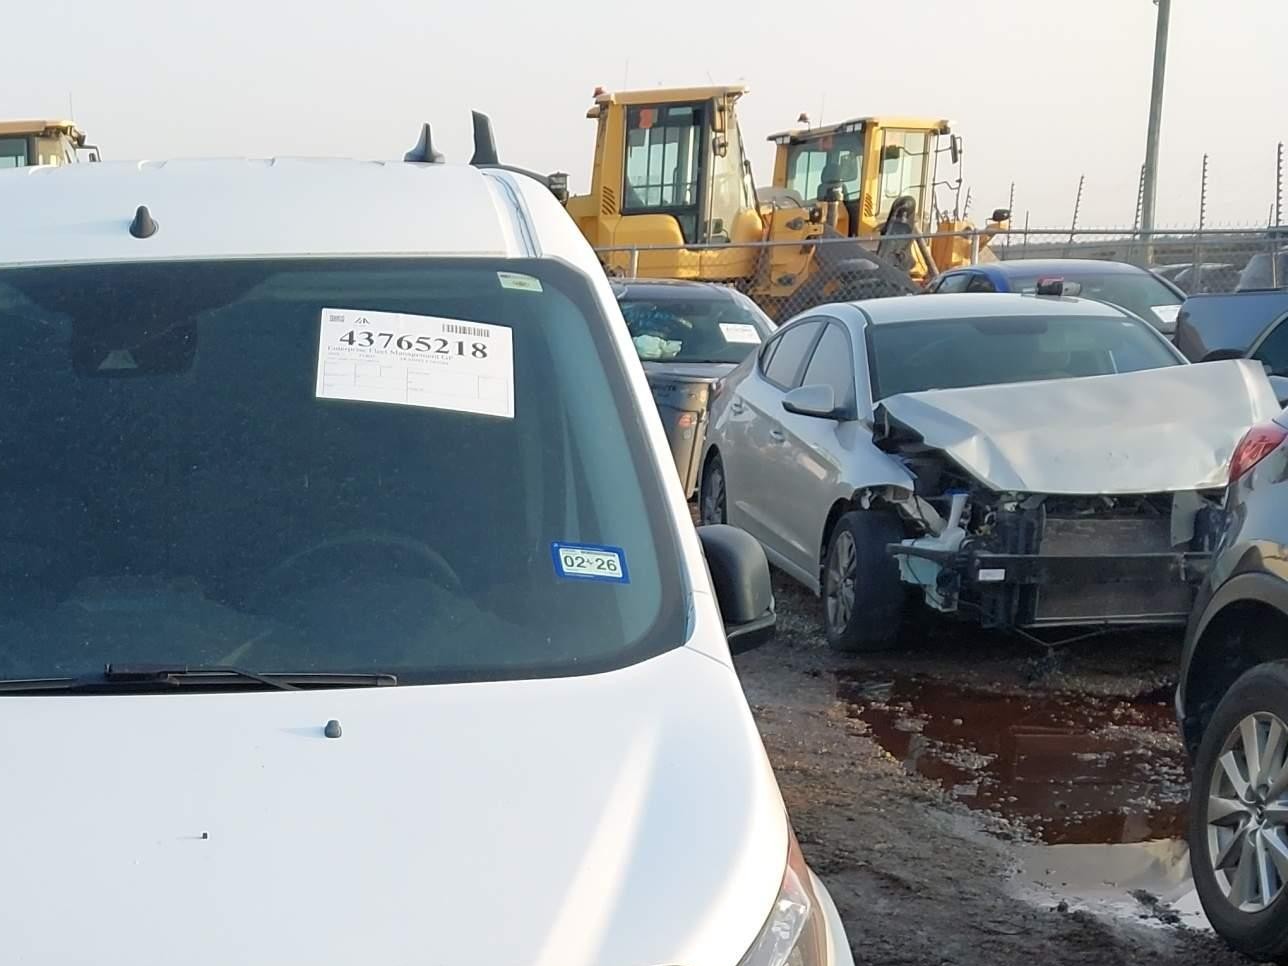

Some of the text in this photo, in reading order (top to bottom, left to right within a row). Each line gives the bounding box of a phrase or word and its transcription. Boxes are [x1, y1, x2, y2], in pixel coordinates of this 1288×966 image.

[339, 330, 488, 360] 43765218
[564, 555, 617, 572] 02 26
